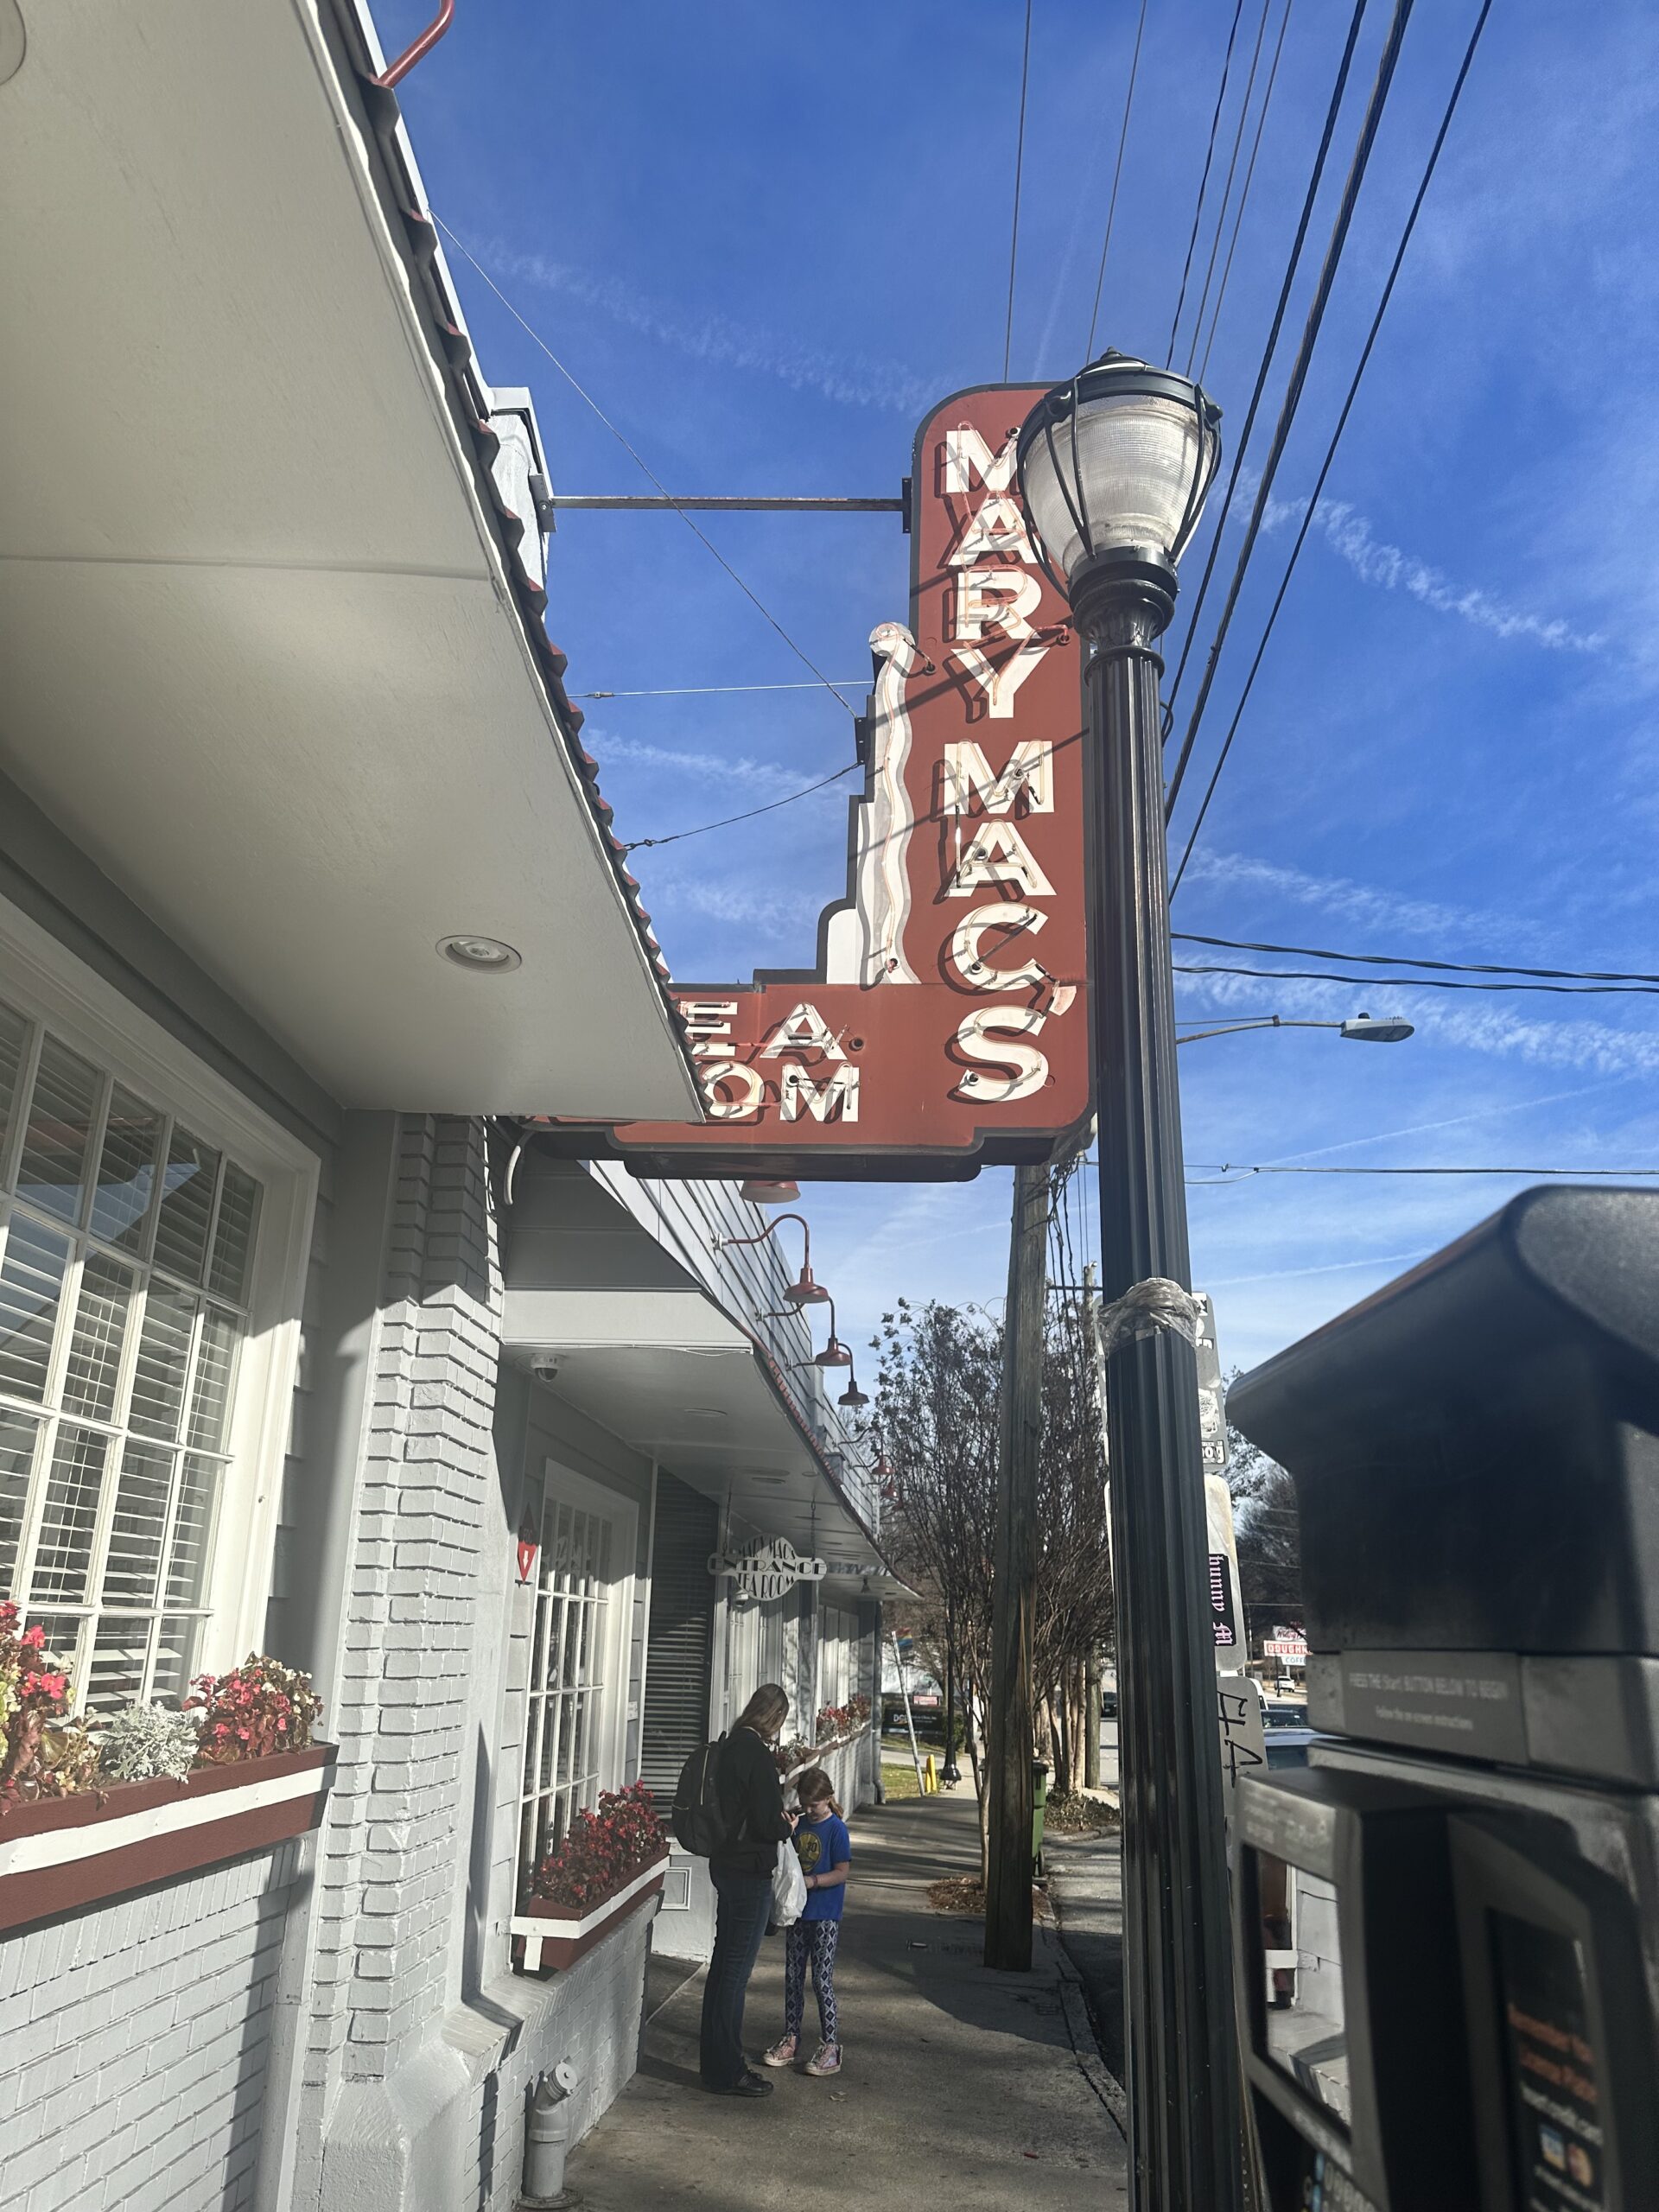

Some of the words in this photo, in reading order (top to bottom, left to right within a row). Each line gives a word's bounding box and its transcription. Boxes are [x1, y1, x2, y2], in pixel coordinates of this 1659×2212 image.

[946, 429, 1051, 718] MARY
[679, 1001, 848, 1060] EA
[702, 1061, 861, 1122] OM
[709, 1556, 827, 1575] ENTRANCE
[736, 1573, 757, 1598] TEA
[760, 1573, 794, 1599] ROOM
